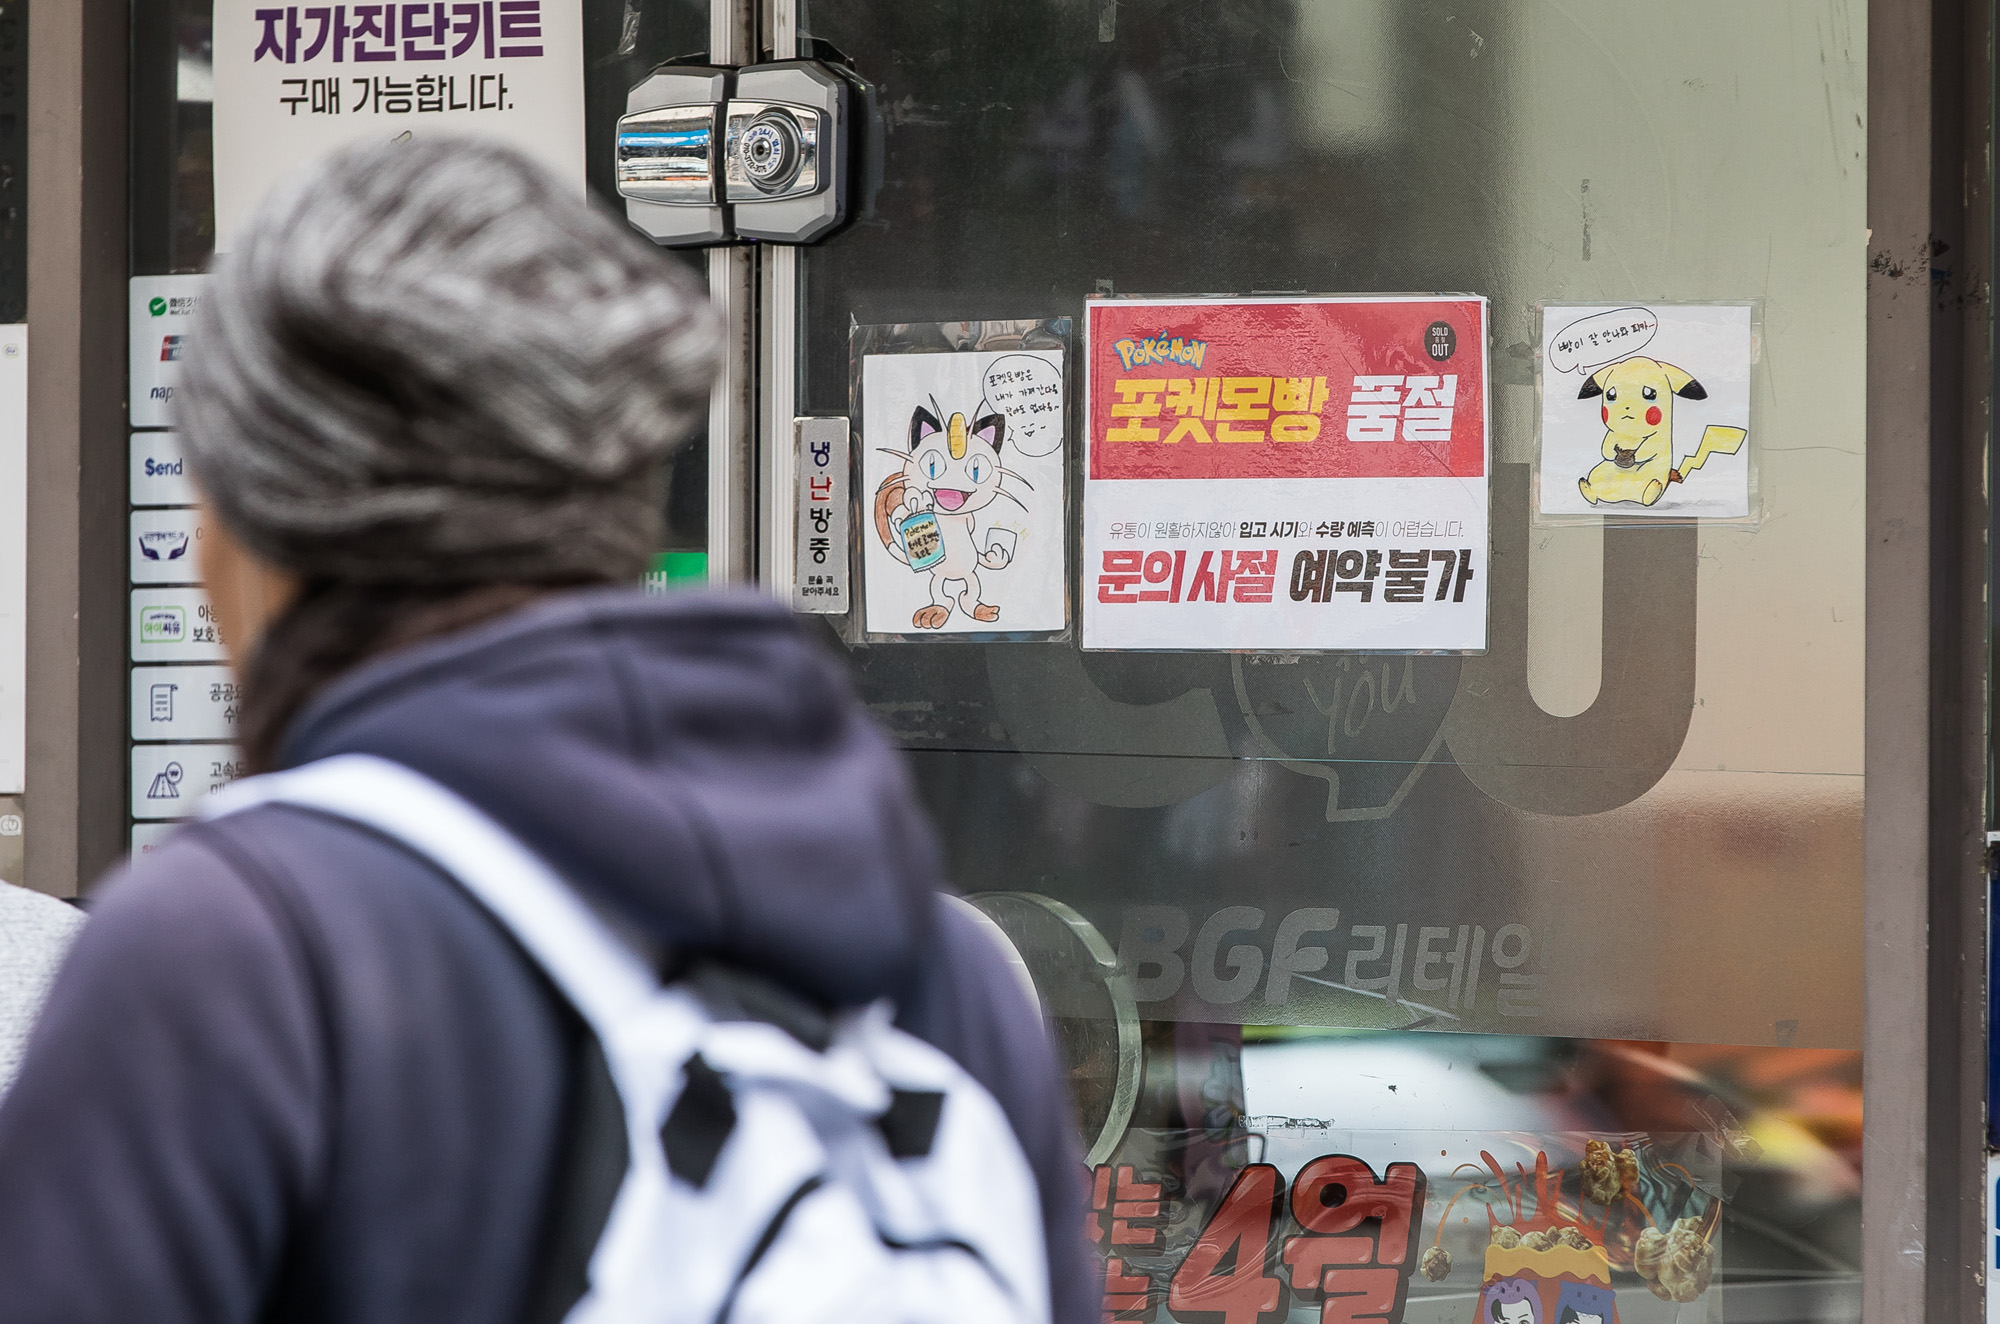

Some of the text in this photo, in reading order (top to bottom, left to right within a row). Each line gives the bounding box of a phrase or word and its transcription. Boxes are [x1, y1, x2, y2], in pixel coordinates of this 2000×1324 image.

[253, 1, 544, 64] 자가진단키트
[280, 73, 514, 116] 구매 가능합니다.
[1431, 327, 1449, 337] SOLD
[1558, 337, 1584, 353] 빵이
[1588, 332, 1599, 346] 잘
[1431, 343, 1449, 357] OUT
[994, 391, 1014, 402] 내가
[1105, 374, 1458, 444] 포켓몬빵 품절
[1109, 521, 1151, 540] 유통이
[1239, 521, 1268, 539] 입고
[1269, 521, 1313, 539] 시기와
[1315, 521, 1345, 538] 수량
[1346, 520, 1389, 538] 예측이
[1392, 520, 1465, 538] 어렵습니다.
[1097, 549, 1475, 604] 문의 사절 예약 불가
